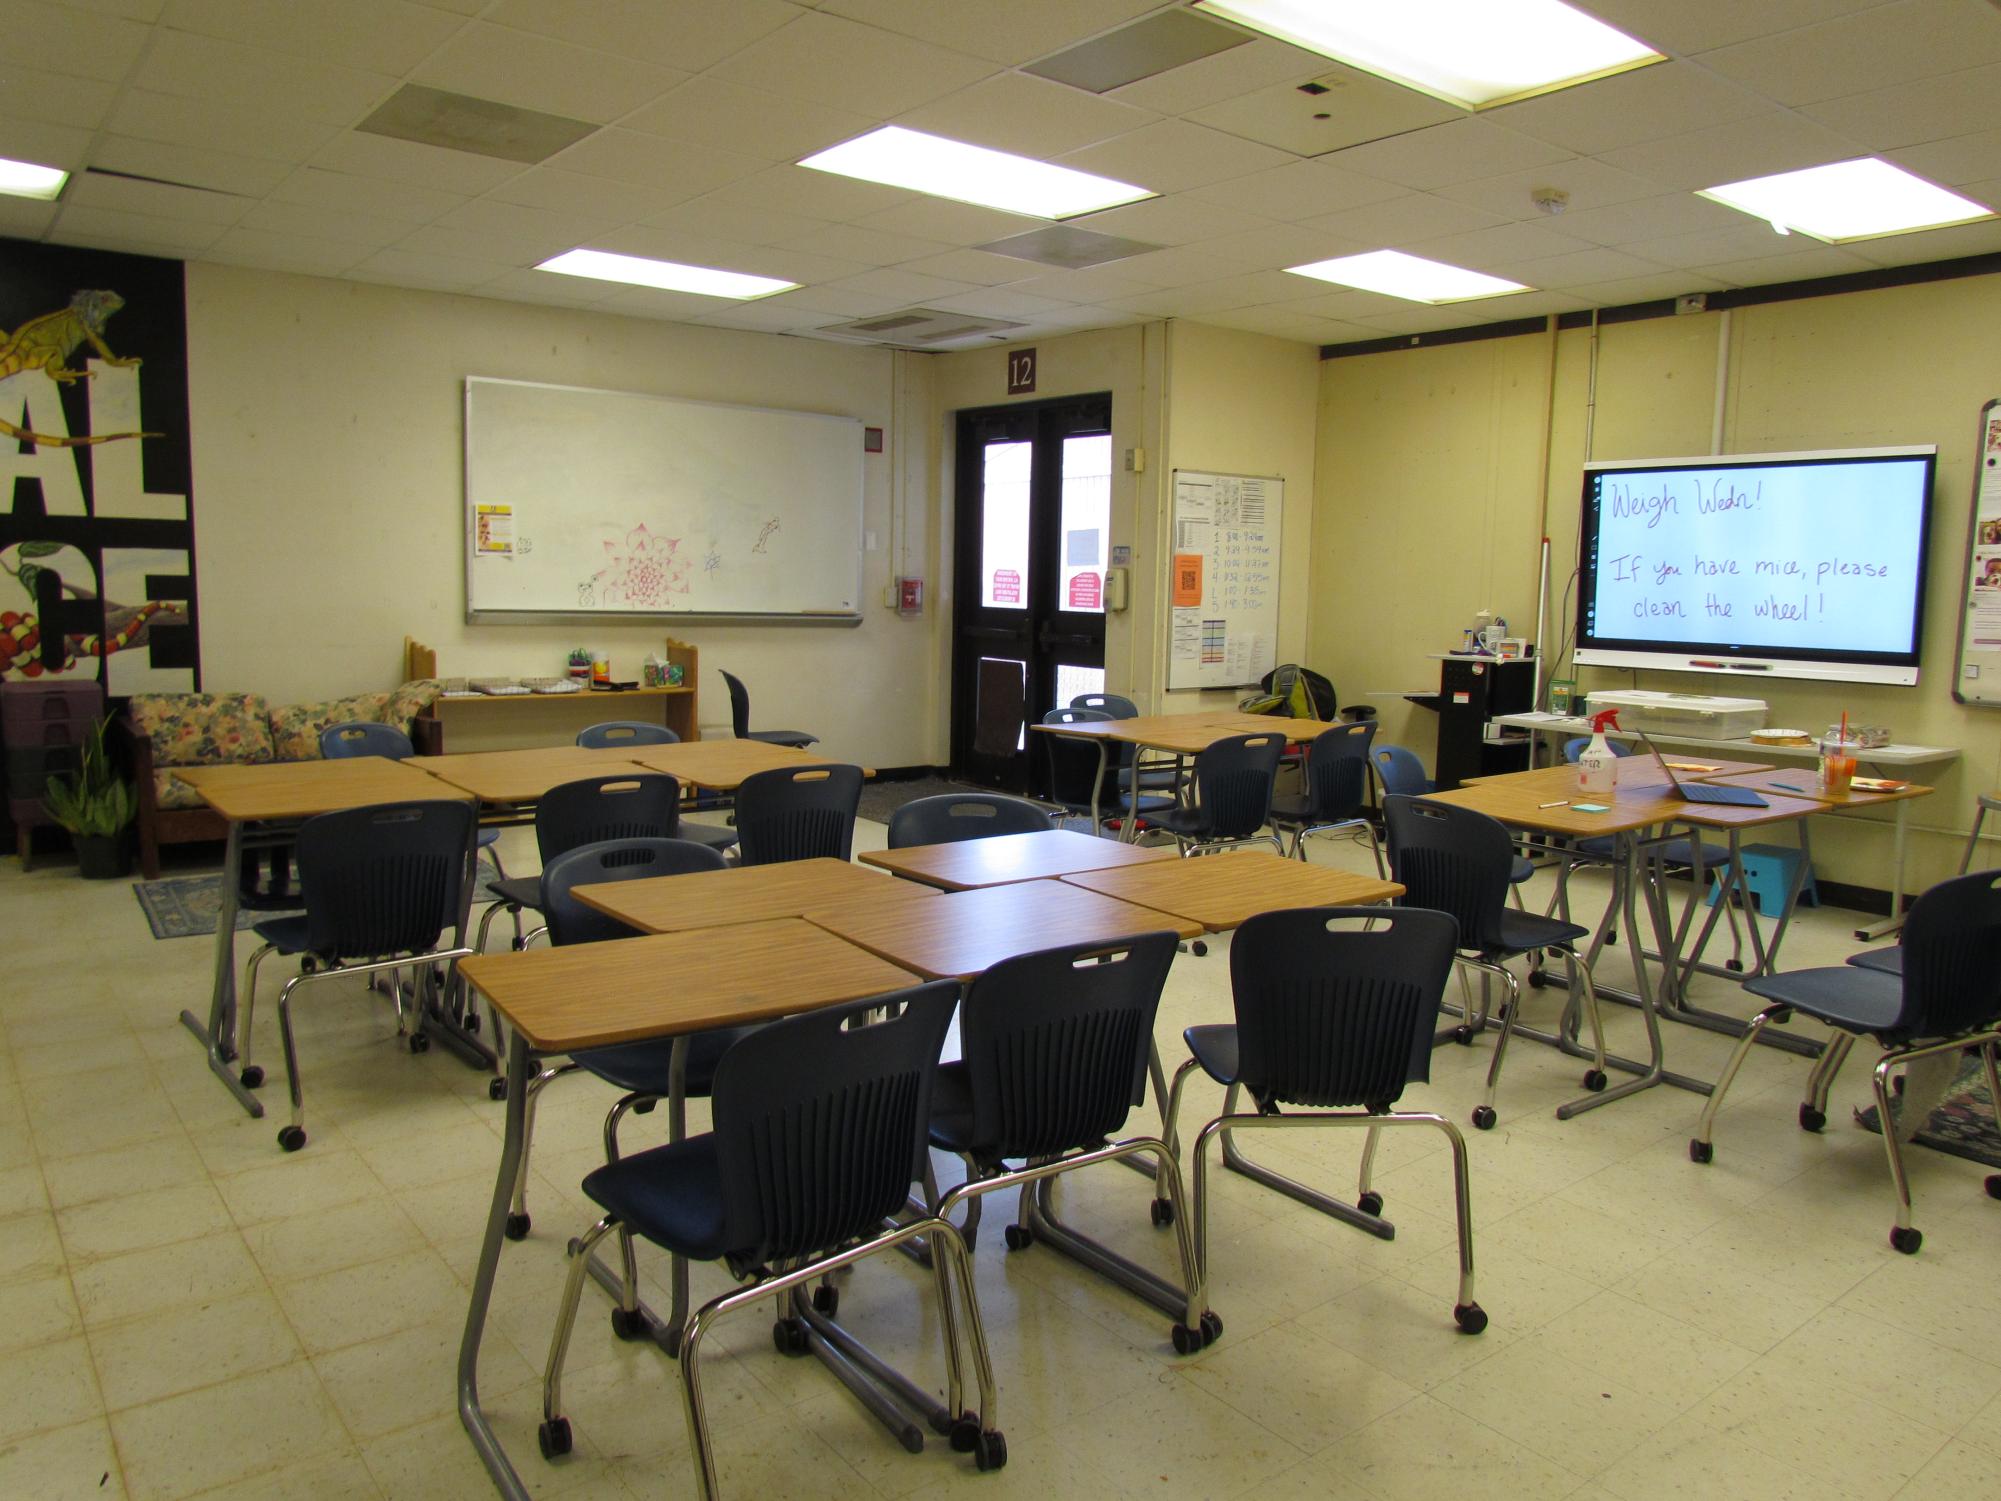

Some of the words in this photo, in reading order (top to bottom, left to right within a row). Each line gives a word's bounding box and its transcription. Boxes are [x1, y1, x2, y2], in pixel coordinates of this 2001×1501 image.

[1011, 357, 1032, 387] 12
[1612, 483, 1679, 529] Weigh
[1609, 554, 1642, 583] If
[1653, 561, 1682, 585] you
[1694, 554, 1740, 576] have
[1755, 559, 1806, 580] mice,
[1817, 557, 1888, 586] please
[1633, 597, 1687, 618] clean
[1705, 592, 1733, 618] the
